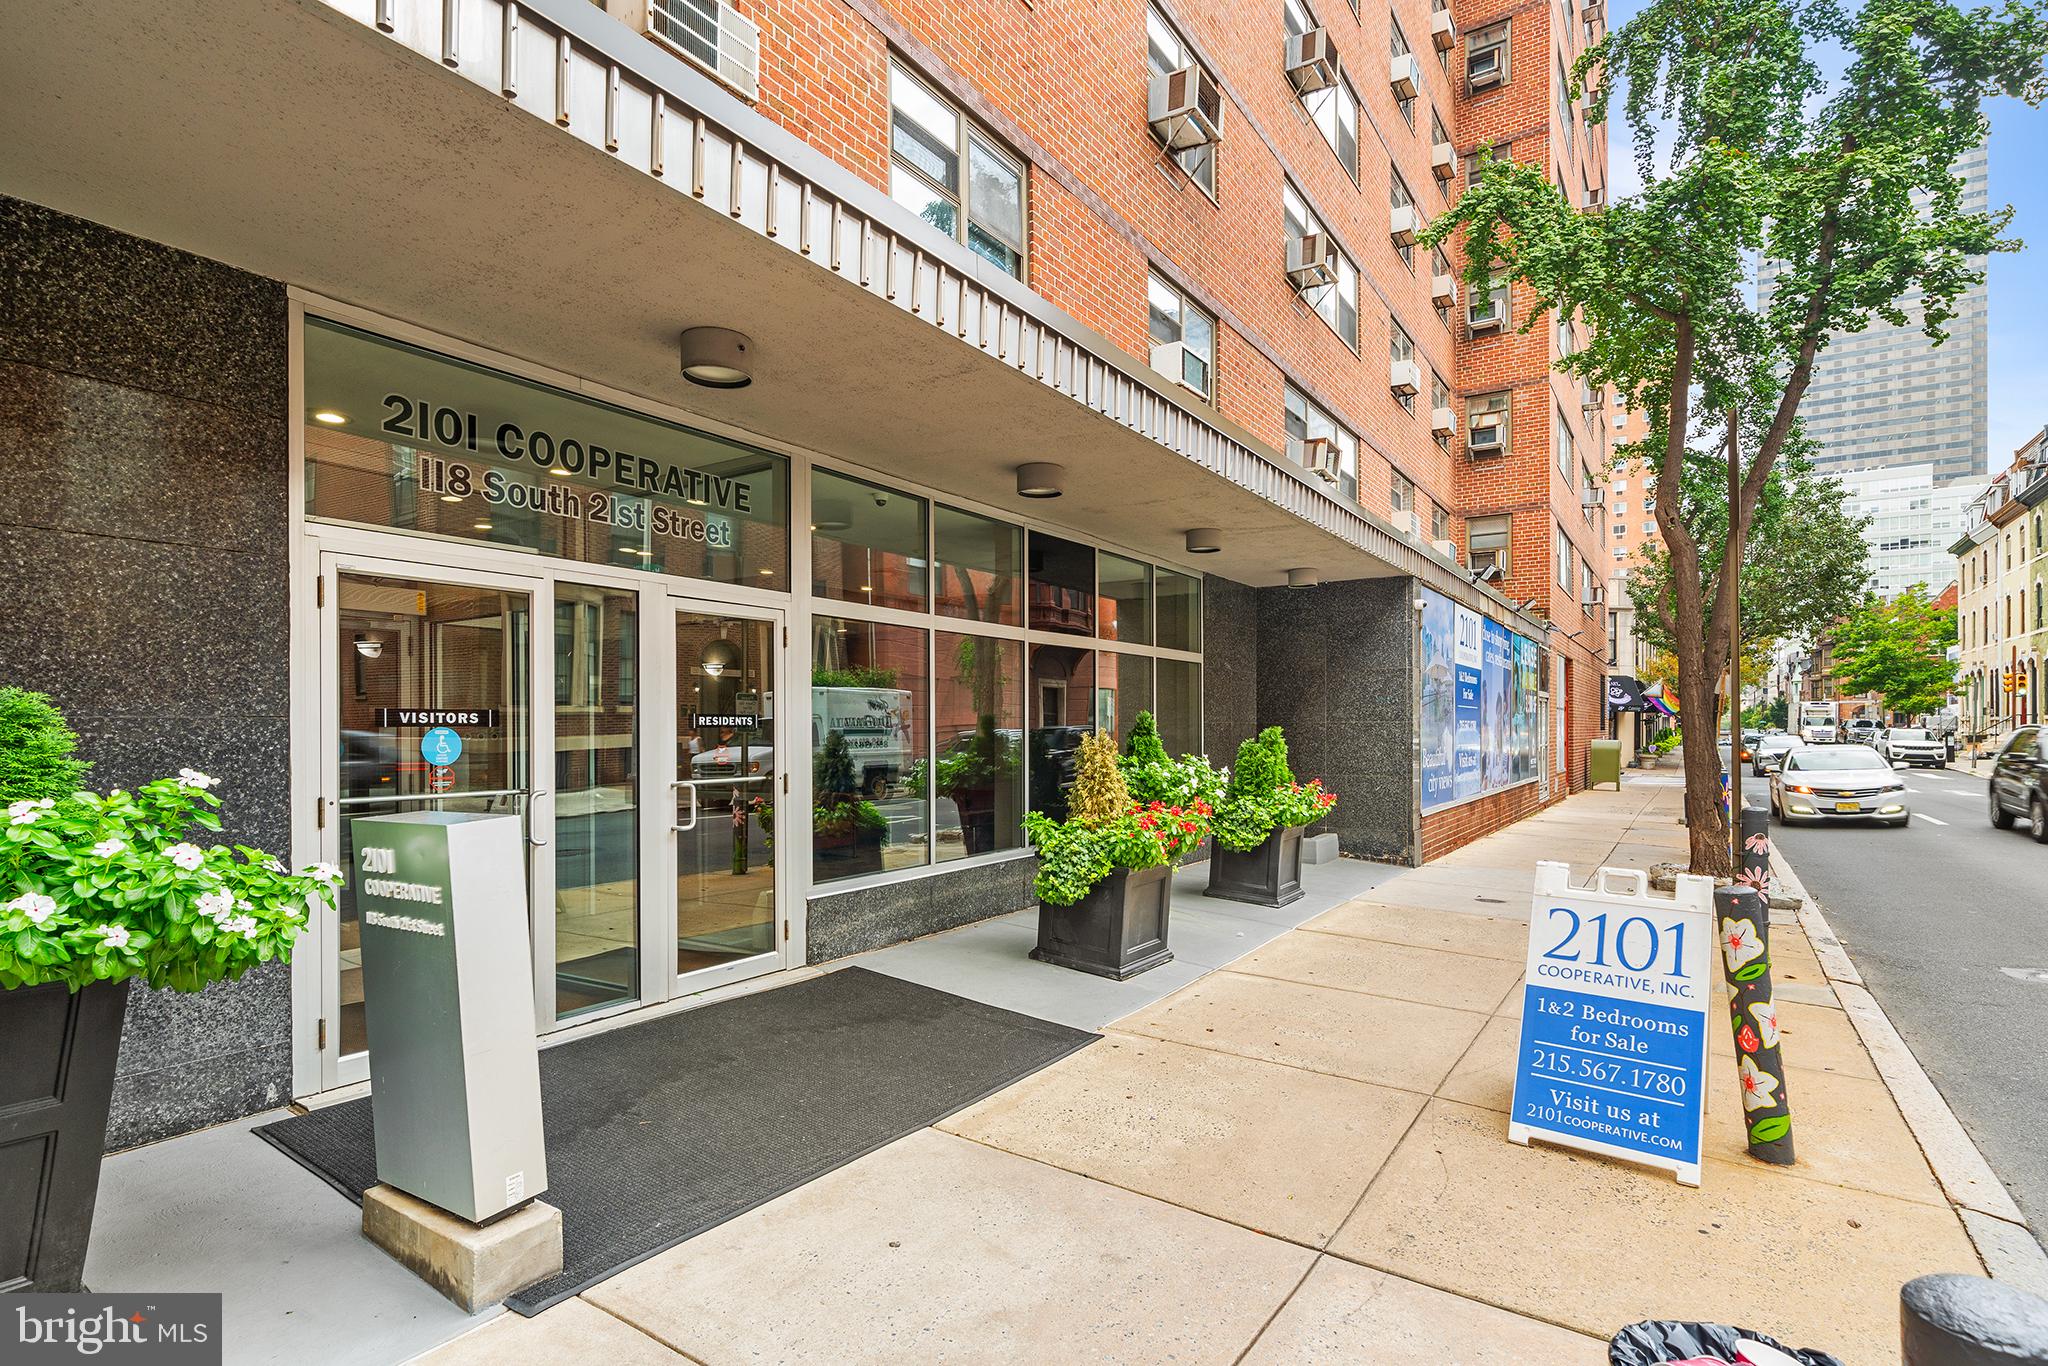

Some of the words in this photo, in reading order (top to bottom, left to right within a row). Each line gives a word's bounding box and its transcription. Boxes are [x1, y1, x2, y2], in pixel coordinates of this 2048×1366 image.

[381, 393, 478, 452] 2101
[496, 422, 752, 514] COOPERATIVE
[420, 456, 473, 498] 118
[481, 470, 580, 519] South
[588, 494, 645, 531] 21st
[651, 506, 731, 548] Street
[1460, 614, 1477, 651] 2101
[399, 711, 479, 725] VISITORS
[698, 716, 753, 726] RESIDENTS
[361, 847, 396, 874] 2101
[365, 878, 442, 905] COOPERATIVE
[1542, 908, 1691, 979] 2101
[1537, 964, 1655, 995] COOPERATIVE,
[1660, 981, 1695, 999] INC.
[1536, 997, 1575, 1018] 1&2
[1581, 1004, 1689, 1037] Bedrooms
[1570, 1025, 1600, 1045] for
[1604, 1032, 1649, 1054] Sale
[1531, 1049, 1686, 1097] 215.567.1780
[1550, 1088, 1599, 1116] Visit
[1607, 1105, 1631, 1122] us
[1639, 1111, 1660, 1129] at
